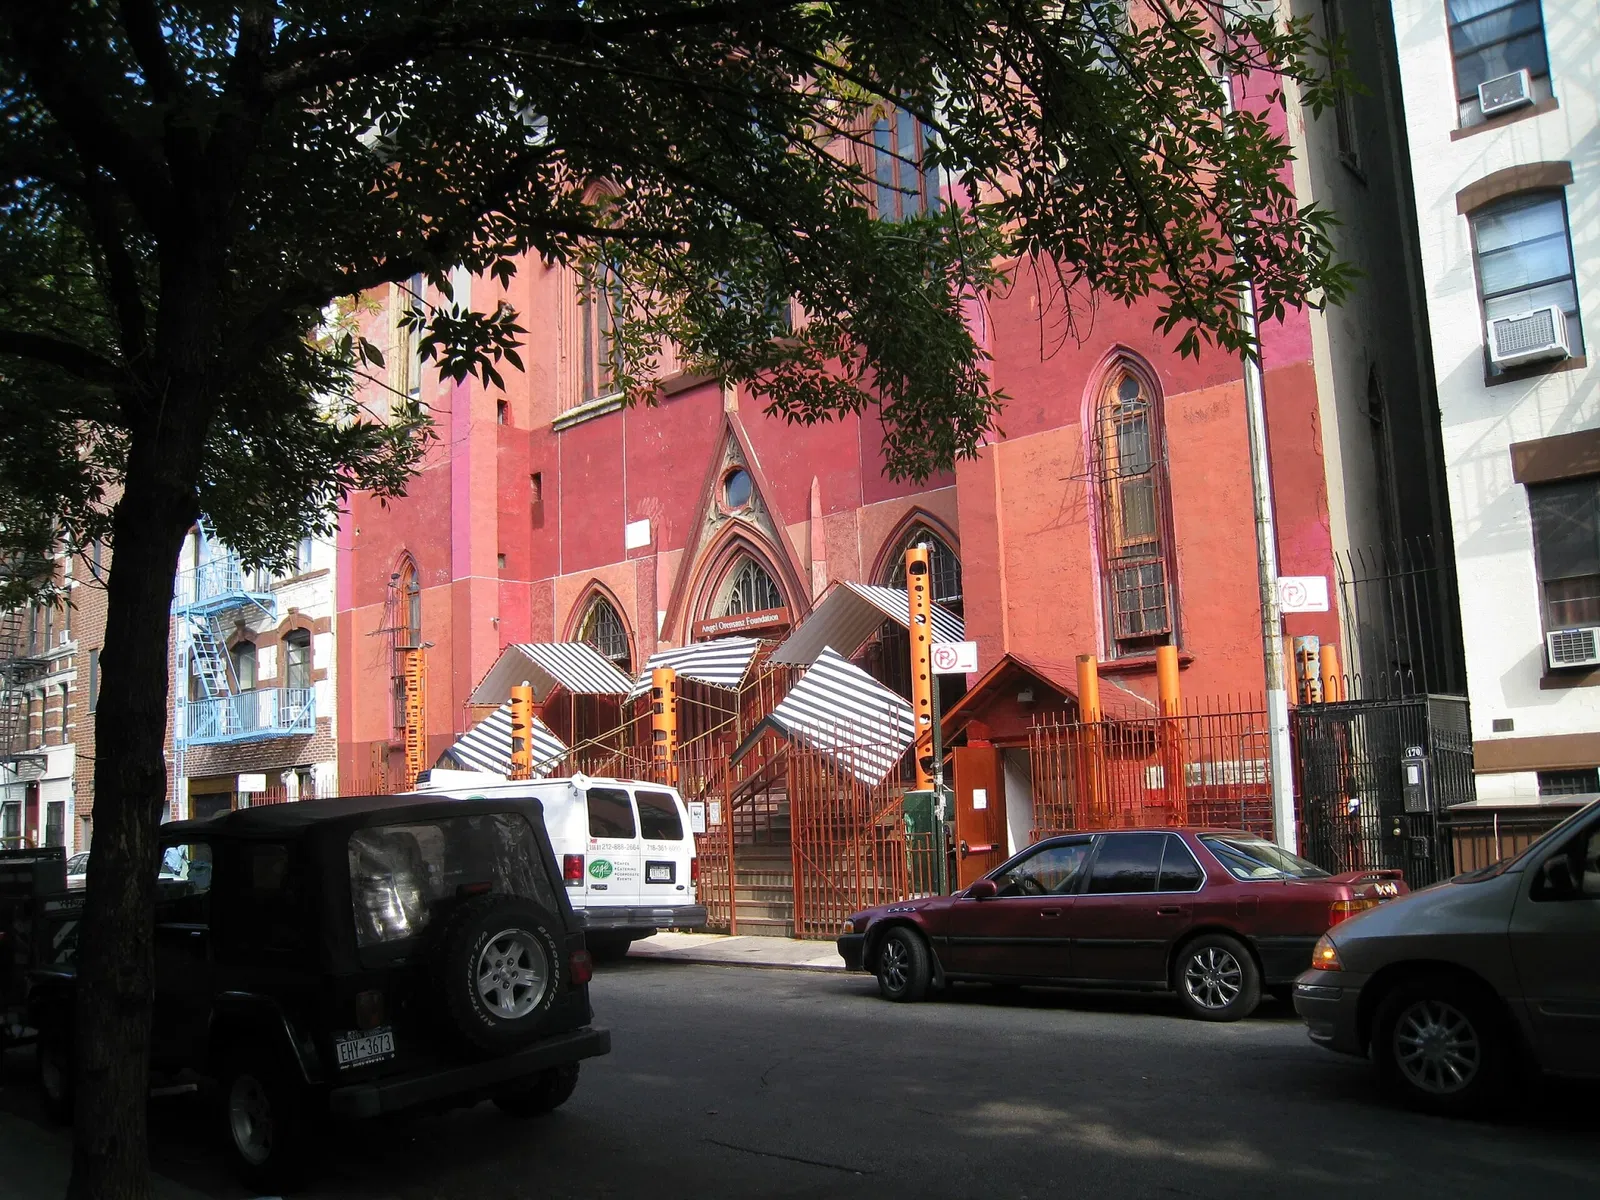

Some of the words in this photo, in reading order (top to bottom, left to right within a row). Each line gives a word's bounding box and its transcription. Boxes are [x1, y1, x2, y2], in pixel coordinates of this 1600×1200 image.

[701, 622, 718, 633] Angel
[746, 613, 779, 626] Foundation
[1407, 748, 1421, 757] 170
